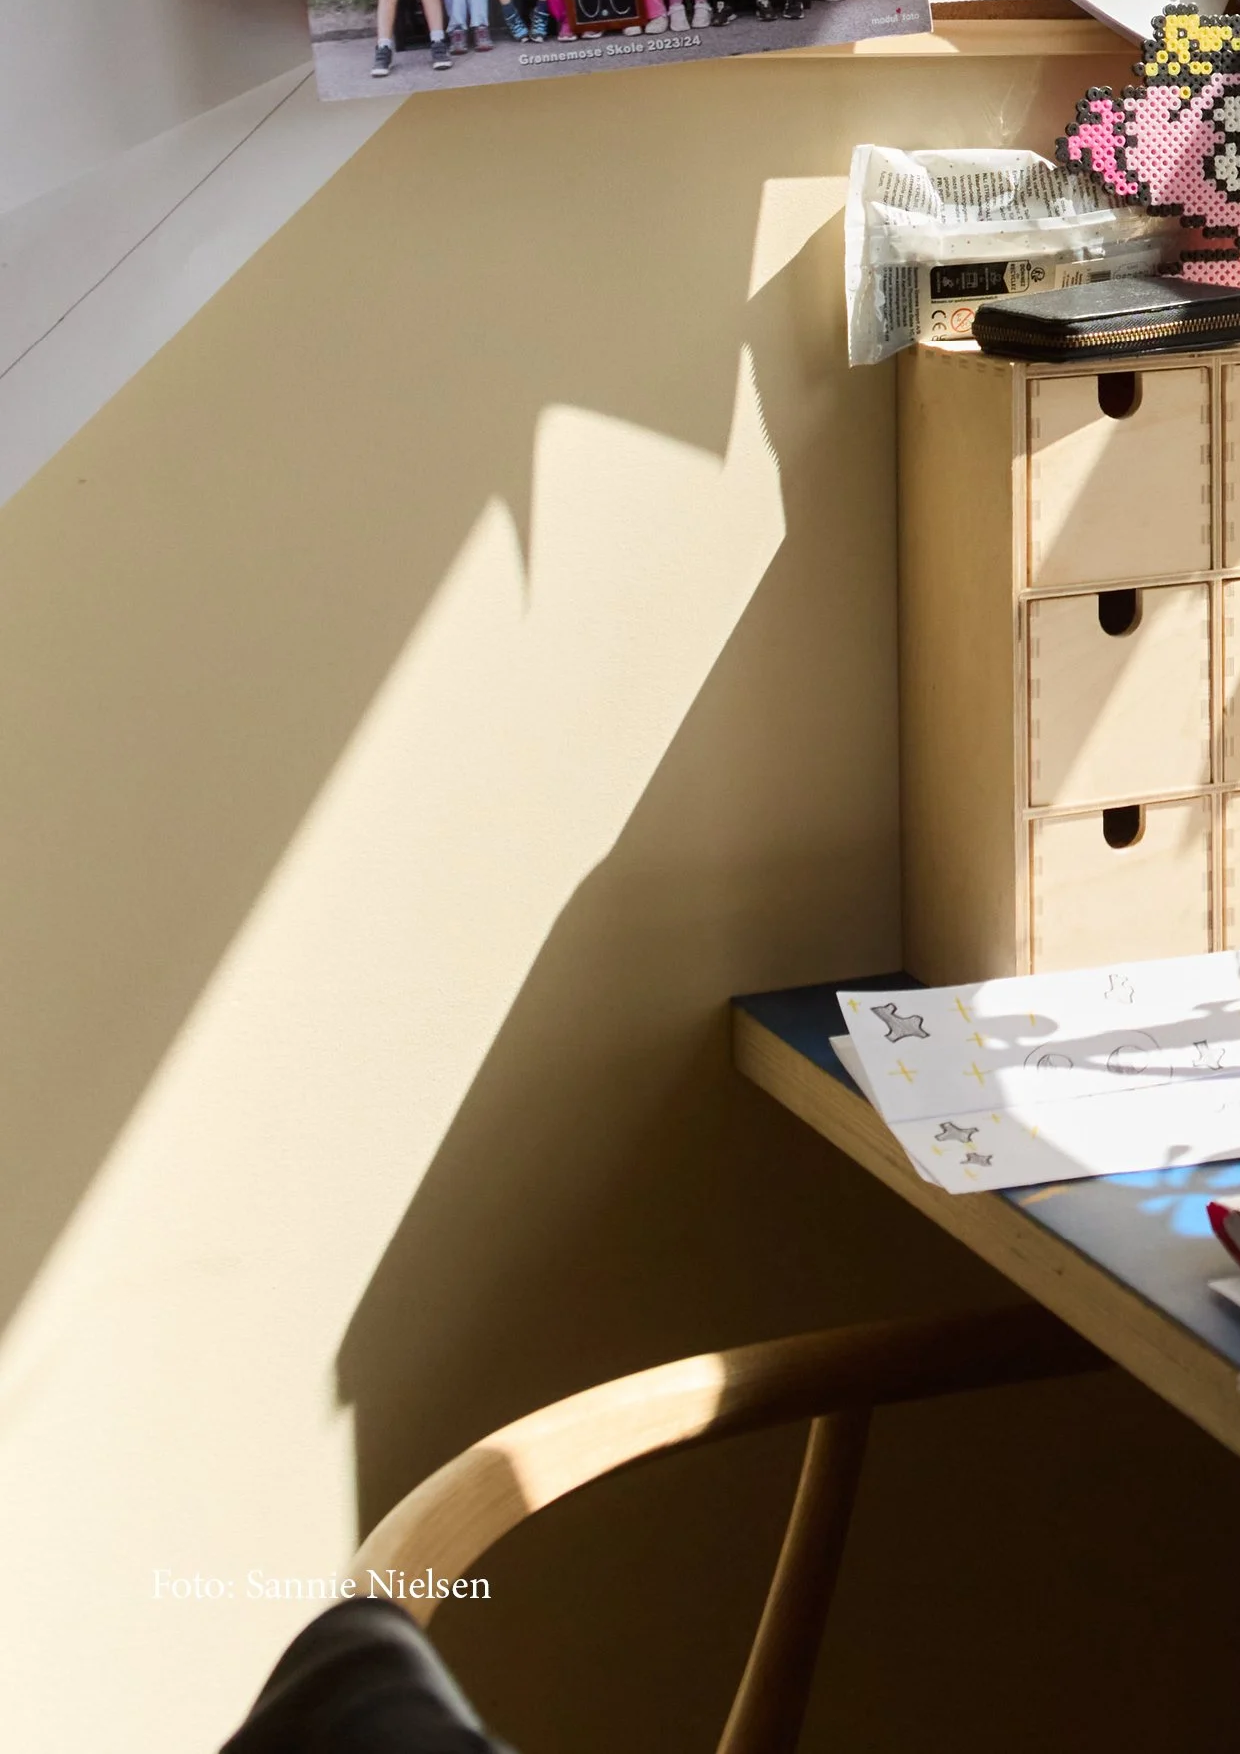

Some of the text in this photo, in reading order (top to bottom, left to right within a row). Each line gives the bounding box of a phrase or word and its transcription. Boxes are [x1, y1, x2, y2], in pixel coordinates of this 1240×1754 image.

[518, 34, 702, 66] Grønnemose Skole 2023/24
